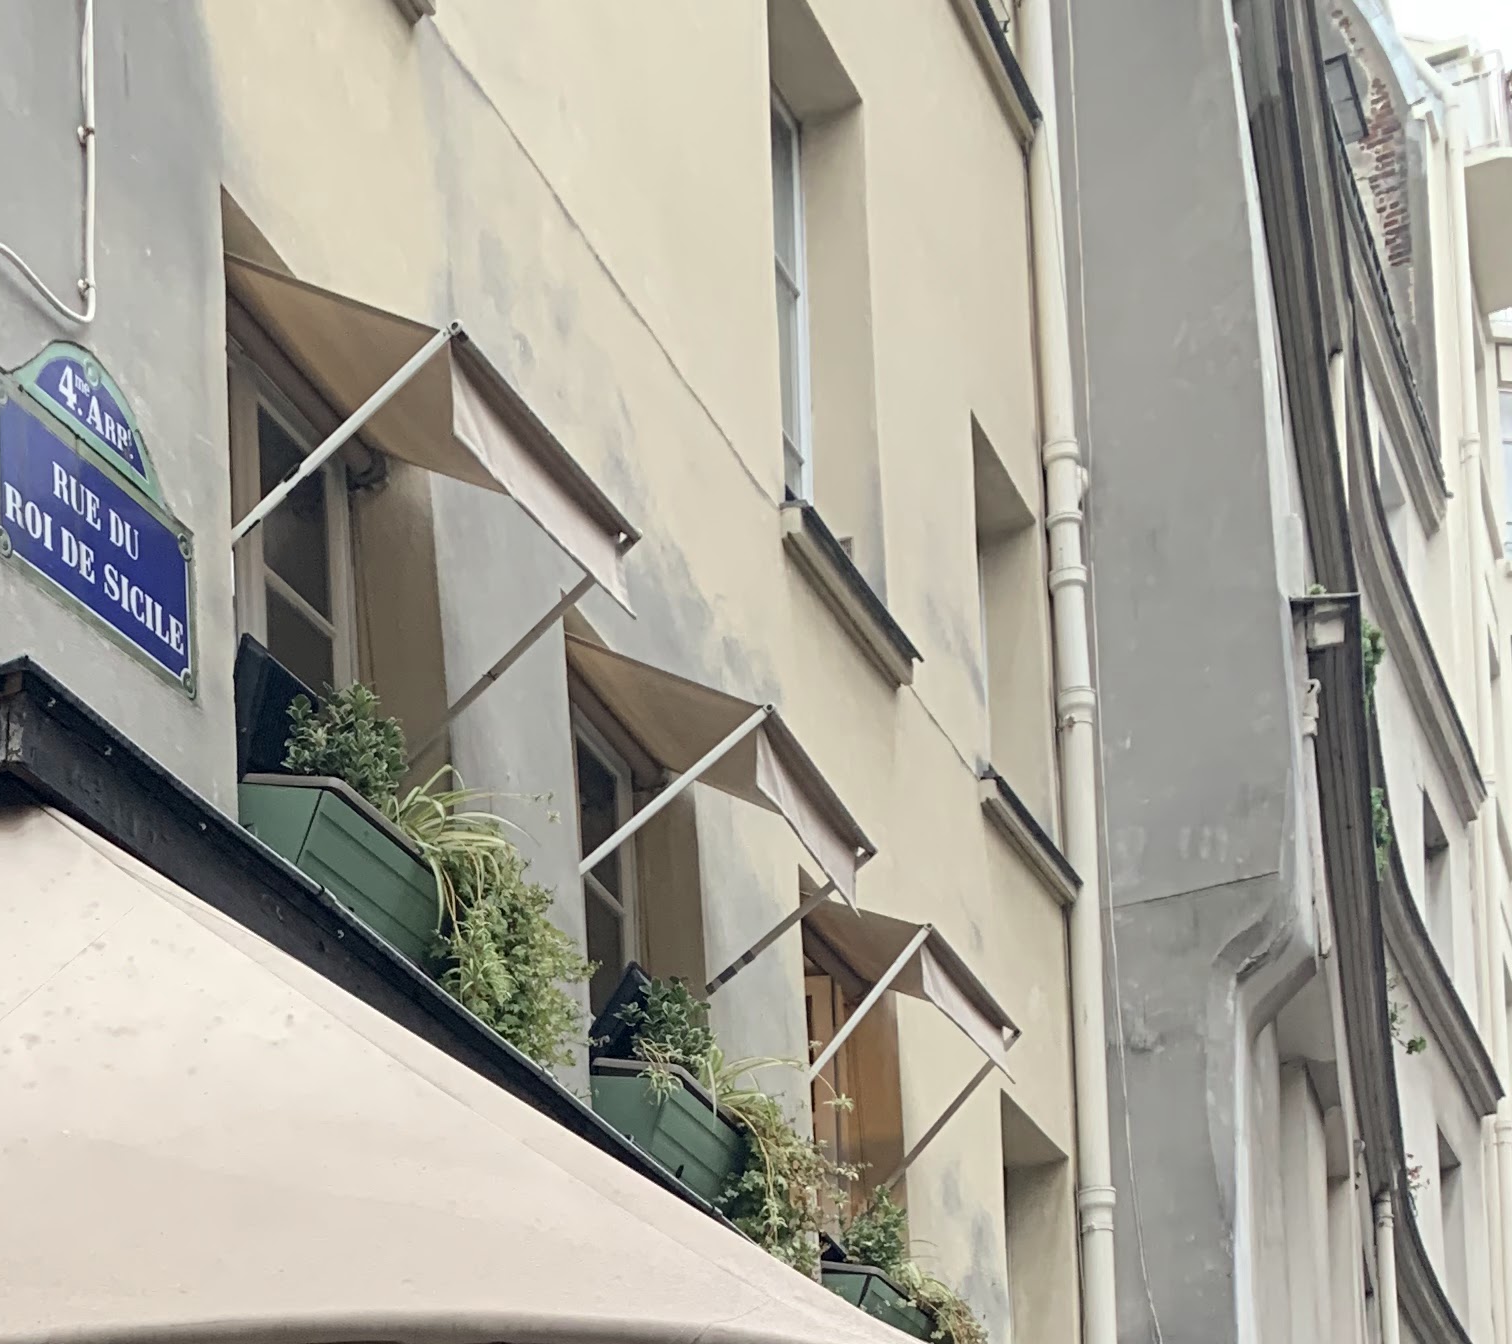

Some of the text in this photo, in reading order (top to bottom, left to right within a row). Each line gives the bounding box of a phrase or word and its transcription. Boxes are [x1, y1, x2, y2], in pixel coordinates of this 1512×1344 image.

[3, 481, 184, 645] ROI DE SICILE
[52, 461, 139, 560] RUE DU
